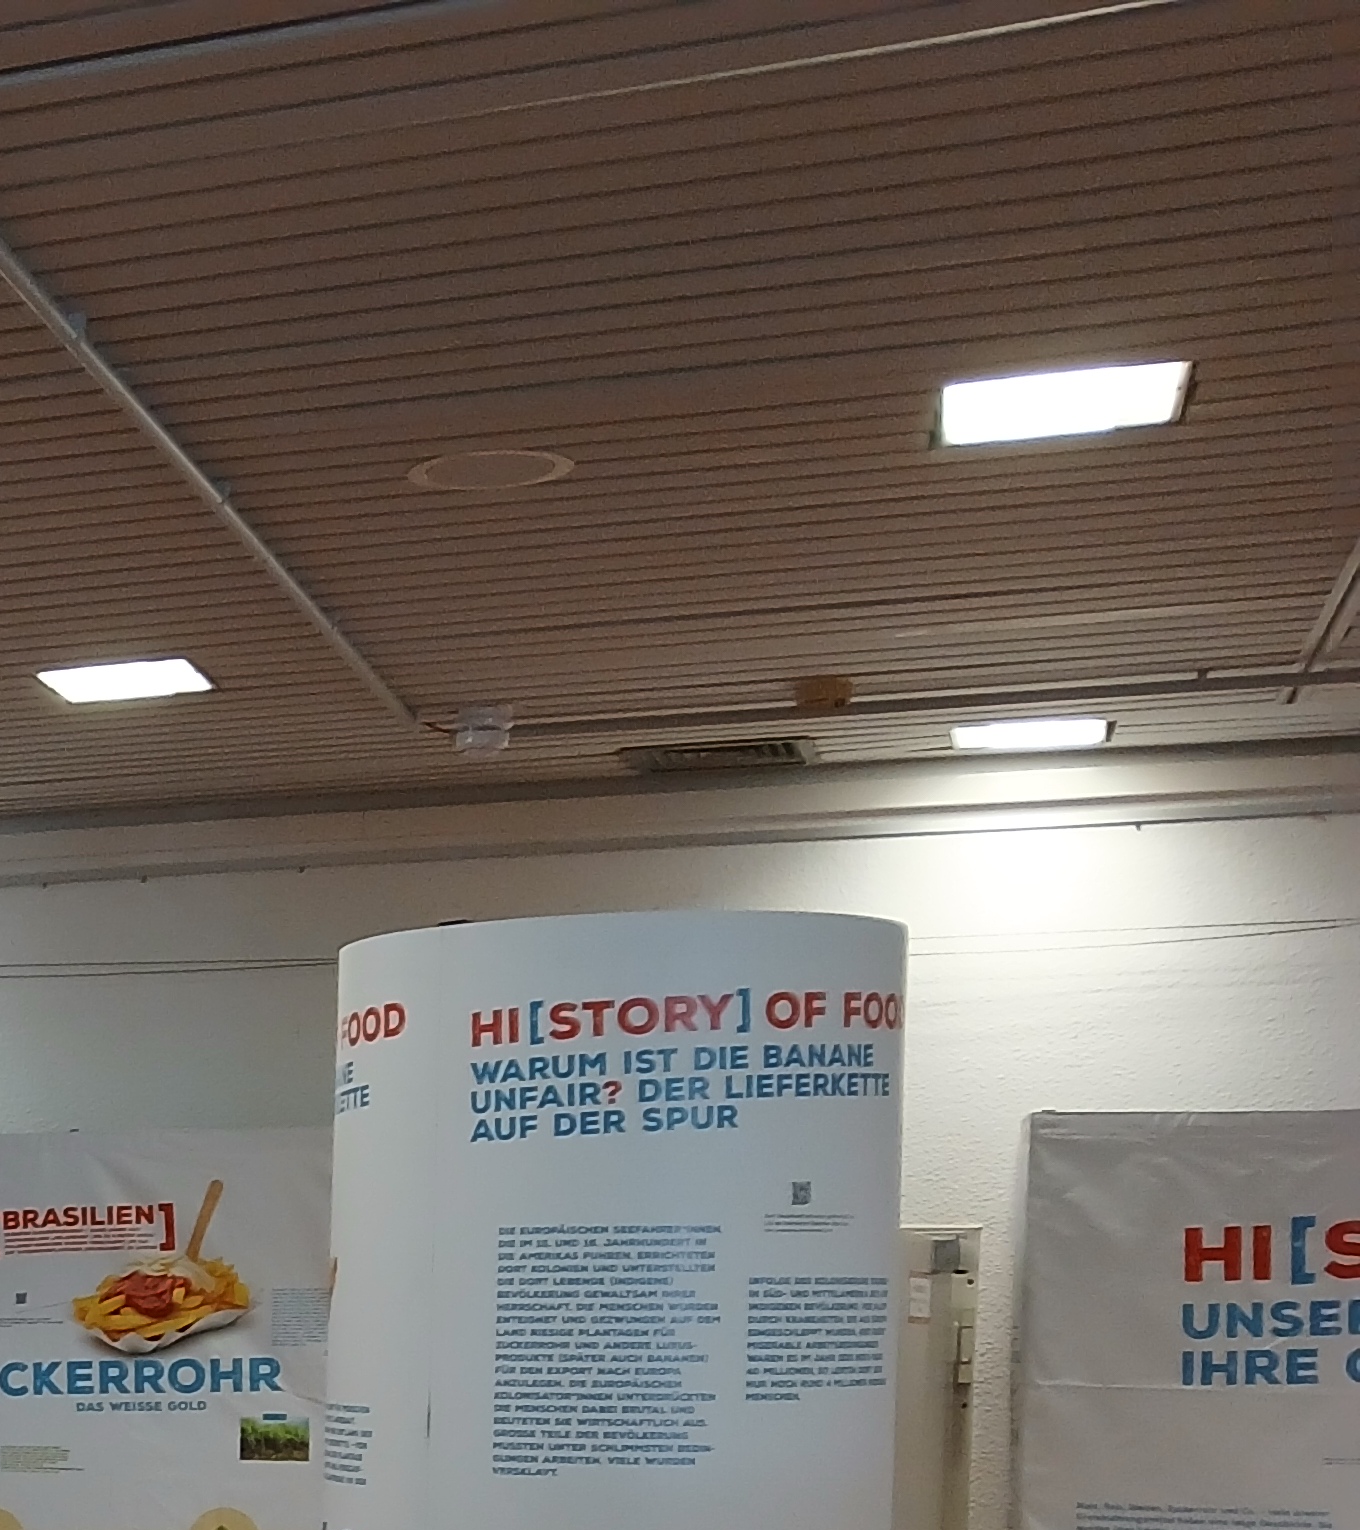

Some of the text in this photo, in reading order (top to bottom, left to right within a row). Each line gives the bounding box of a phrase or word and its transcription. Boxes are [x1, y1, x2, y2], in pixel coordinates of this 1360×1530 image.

[471, 987, 752, 1048] HI[STORY]
[765, 991, 827, 1030] OF
[471, 1043, 874, 1085] WARUM IST DIE BANANE
[470, 1072, 890, 1114] UNFAIR? DER LIEFERKETTE
[470, 1103, 739, 1144] AUF DER SPUR
[2, 1204, 155, 1231] BRASILIEN
[1184, 1215, 1360, 1286] HI[S
[1182, 1348, 1320, 1386] IHRE
[76, 1400, 207, 1411] DAS WEISSE GOLD
